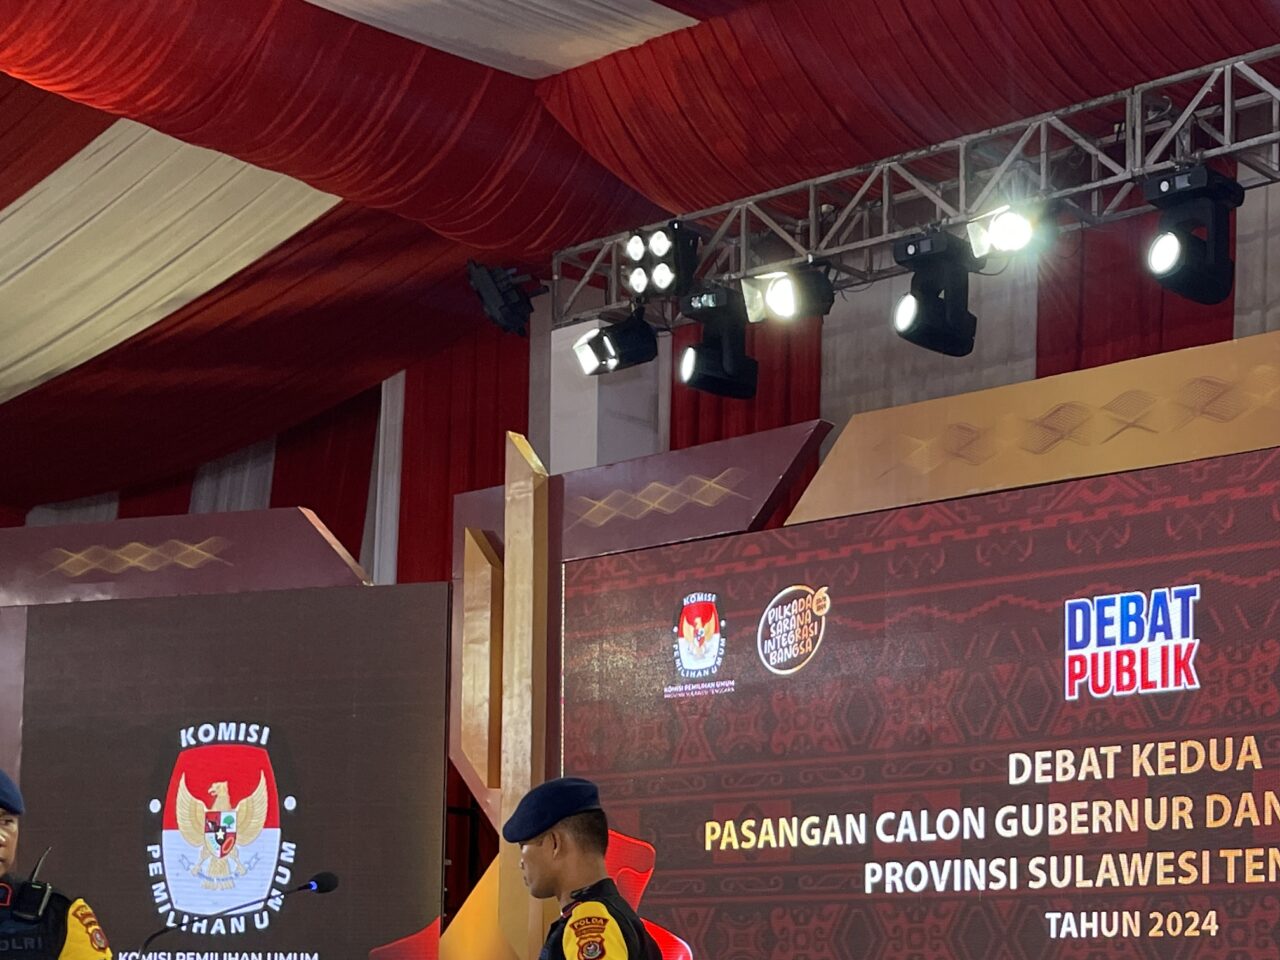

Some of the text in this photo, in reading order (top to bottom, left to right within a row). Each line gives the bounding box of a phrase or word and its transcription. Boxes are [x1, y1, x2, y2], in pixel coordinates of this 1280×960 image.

[683, 592, 717, 606] KOMISI
[768, 594, 813, 625] PILKADA
[770, 609, 812, 638] SARANA
[1066, 585, 1199, 650] DEBAT
[764, 621, 818, 654] INTEGRASI
[769, 637, 813, 666] BANGSA
[1066, 641, 1199, 699] PUBLIK
[180, 722, 270, 748] KOMISI
[1008, 735, 1262, 785] DEBAT KEDUA
[705, 813, 866, 851] PASANGAN
[875, 806, 985, 843] CALON
[994, 795, 1194, 838] GUBERNUR
[864, 857, 1017, 894] PROVINSI
[1027, 849, 1210, 890] SULAWESI
[147, 841, 296, 935] PEMILIHAN UMUM
[573, 917, 604, 929] POLDA
[1045, 909, 1219, 939] TAHUN 2024
